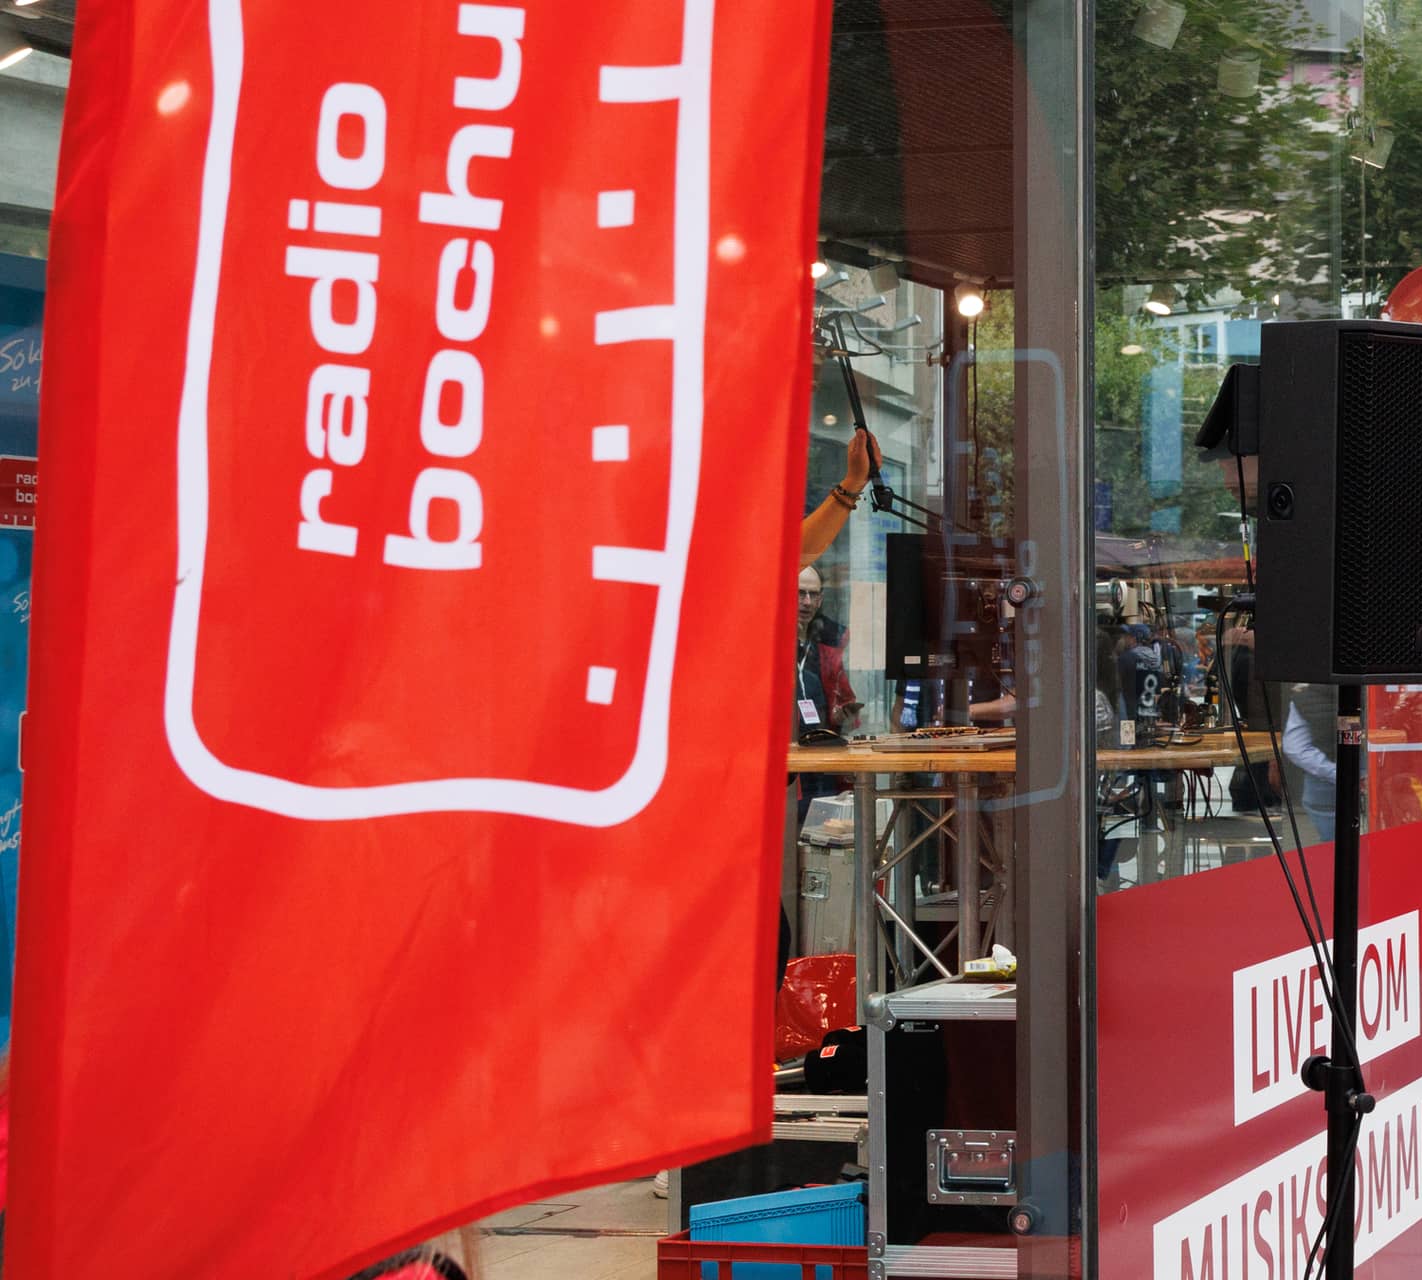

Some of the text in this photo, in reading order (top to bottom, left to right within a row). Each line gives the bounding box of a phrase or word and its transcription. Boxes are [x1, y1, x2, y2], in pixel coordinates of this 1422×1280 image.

[285, 81, 387, 558] radio
[1251, 932, 1409, 1094] LIVE OM
